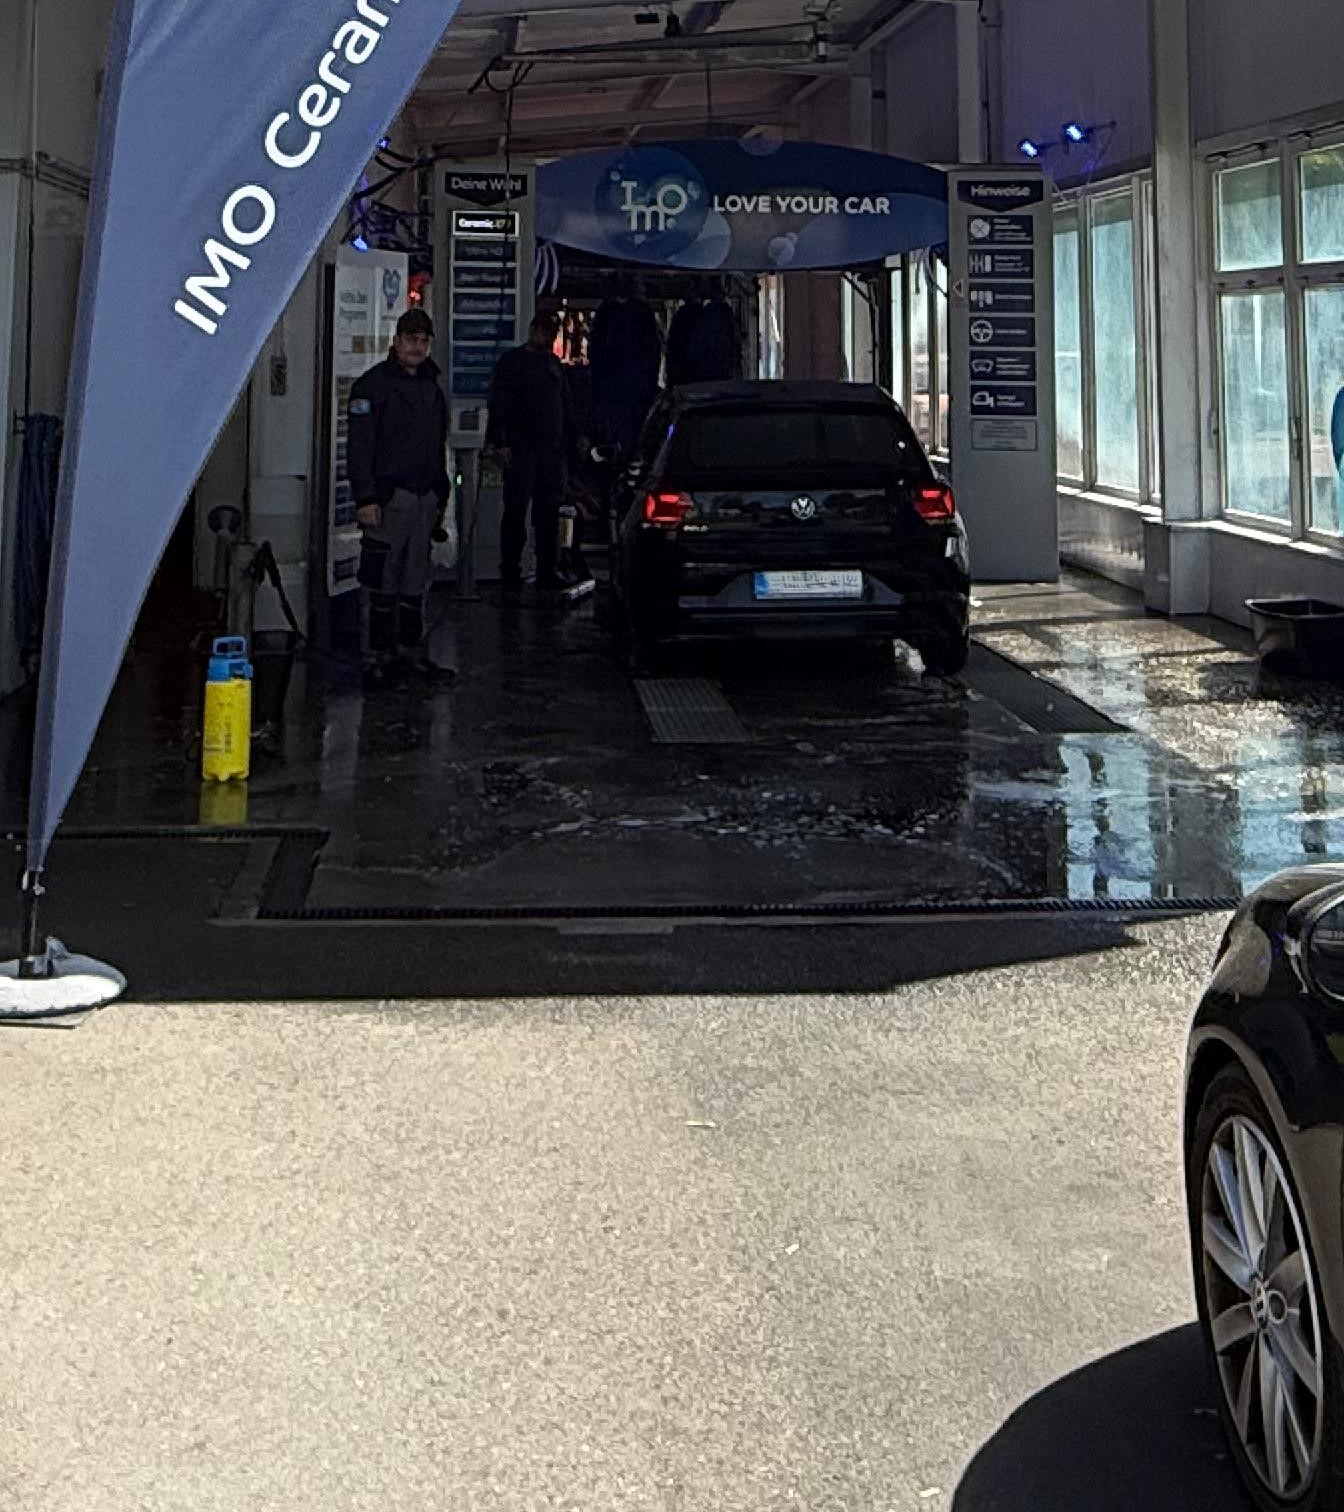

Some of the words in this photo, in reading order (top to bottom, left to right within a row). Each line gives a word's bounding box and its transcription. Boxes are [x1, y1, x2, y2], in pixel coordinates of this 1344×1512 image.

[713, 194, 773, 214] LOVE
[776, 195, 840, 215] YOUR
[844, 196, 891, 215] CAR
[174, 183, 277, 336] IMO
